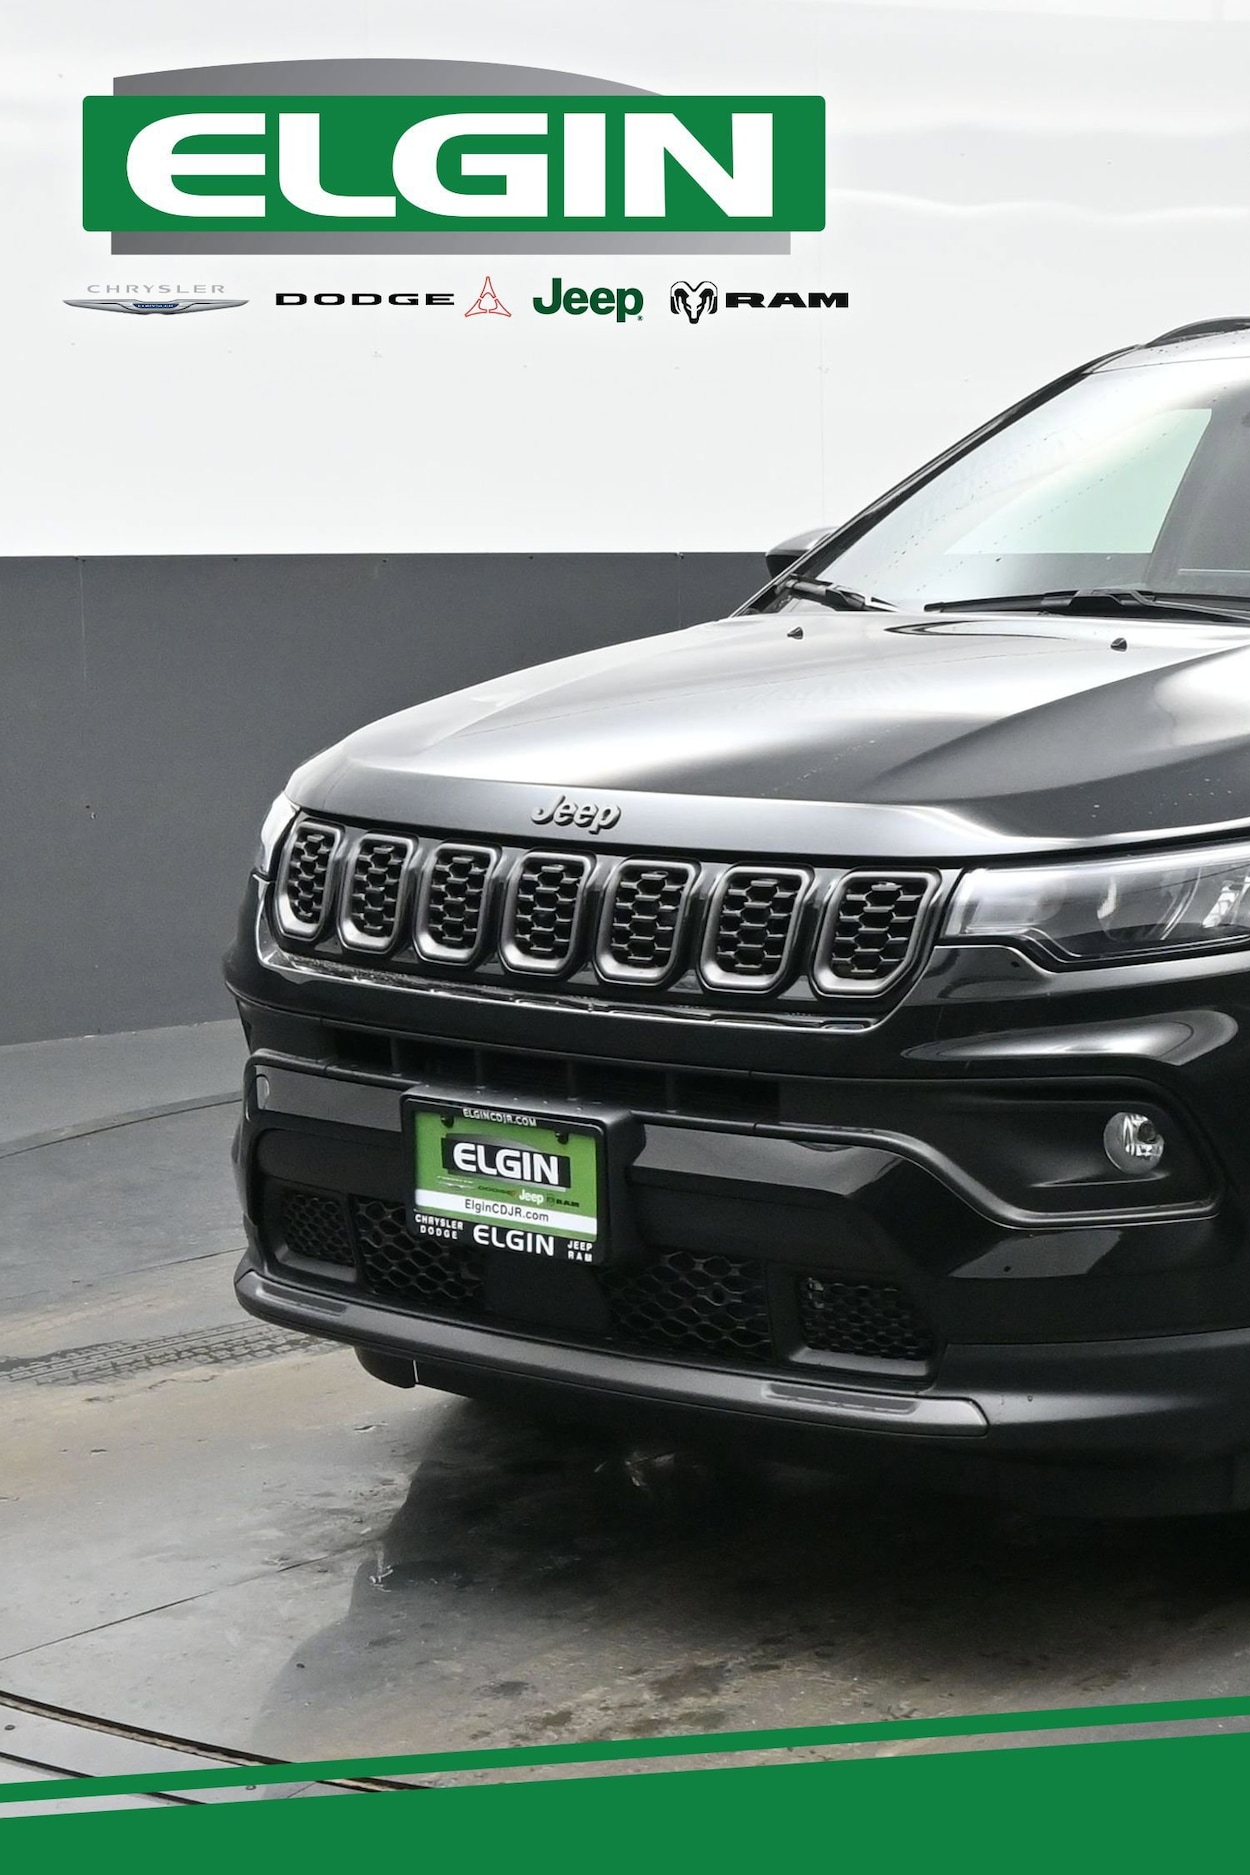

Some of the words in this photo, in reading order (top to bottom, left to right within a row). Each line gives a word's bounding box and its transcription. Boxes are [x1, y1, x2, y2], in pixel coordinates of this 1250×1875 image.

[531, 795, 621, 835] Jeep
[463, 1108, 537, 1127] ELGINCDJR.COM
[453, 1142, 559, 1185] ELGIN
[519, 1189, 544, 1205] Jeep
[464, 1198, 549, 1222] ElginCDJR.com
[415, 1213, 463, 1230] CHRYSLER
[420, 1225, 458, 1240] DODGE
[473, 1224, 555, 1256] ELGIN
[567, 1240, 593, 1252] JEEP
[568, 1251, 592, 1263] RAM
